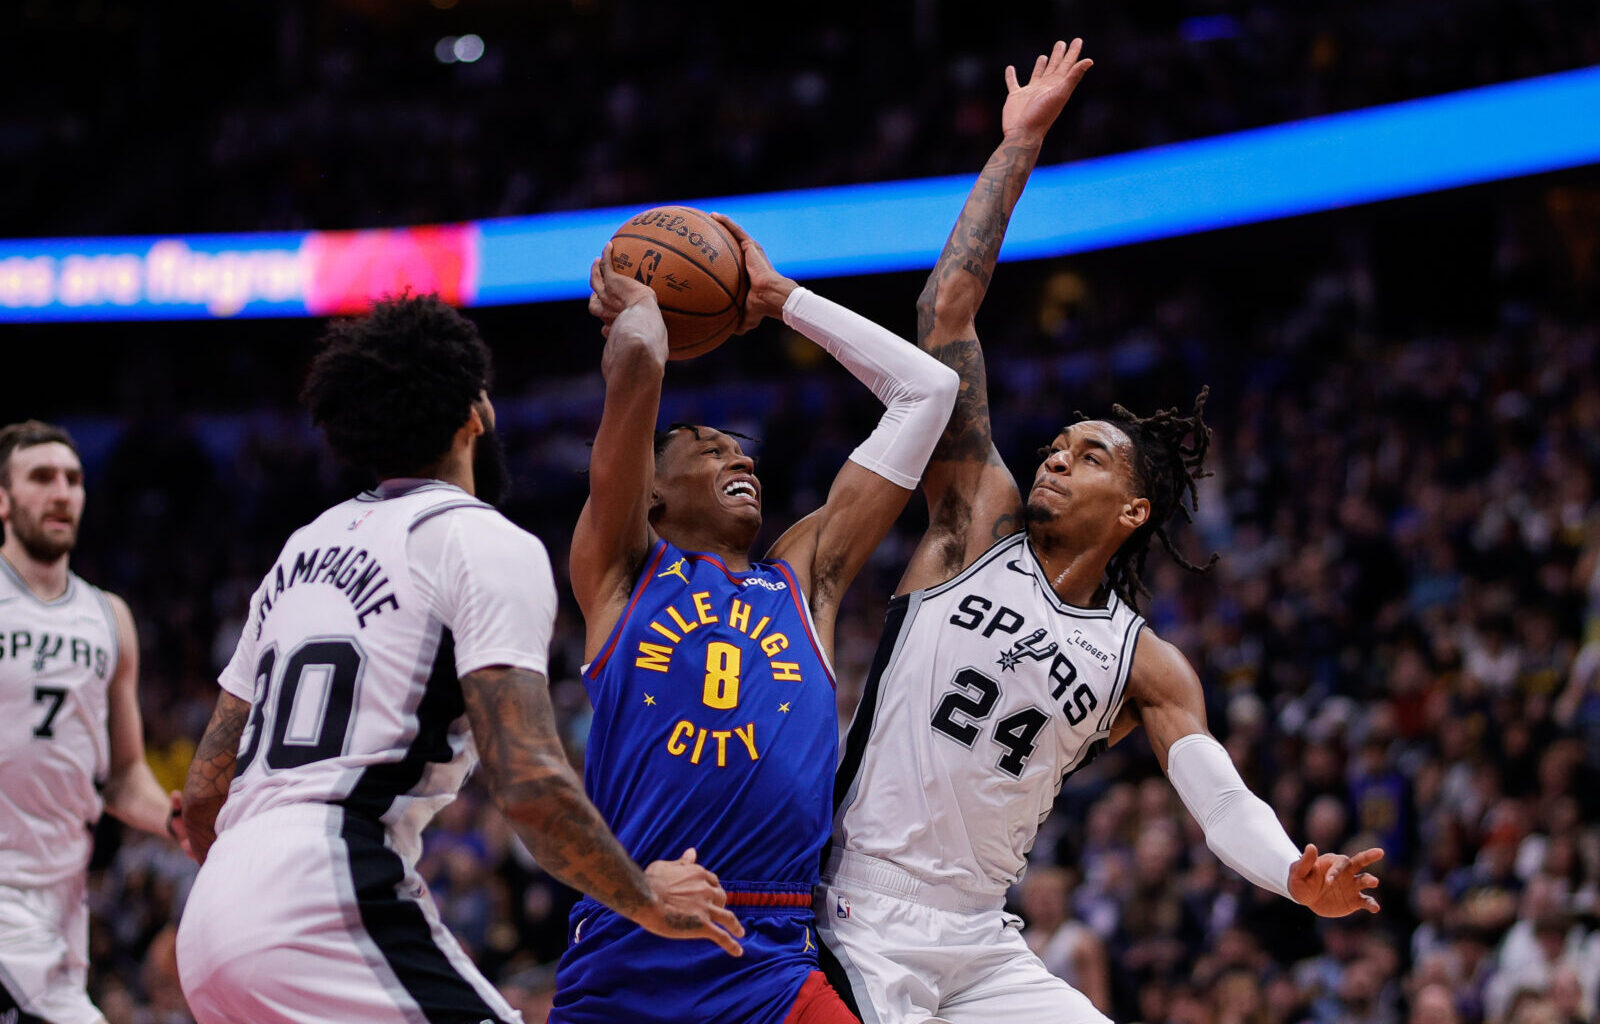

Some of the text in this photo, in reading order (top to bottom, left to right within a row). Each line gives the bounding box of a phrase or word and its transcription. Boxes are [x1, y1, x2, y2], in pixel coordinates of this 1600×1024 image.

[631, 210, 720, 264] Wilson
[255, 545, 400, 641] HAMPAGNIE
[634, 591, 803, 683] MILE HIGH
[949, 594, 1098, 727] SPURS
[1073, 633, 1111, 665] LEDGER
[701, 640, 743, 711] 8
[32, 687, 69, 739] 7
[666, 719, 760, 768] CITY
[930, 665, 1053, 782] 24
